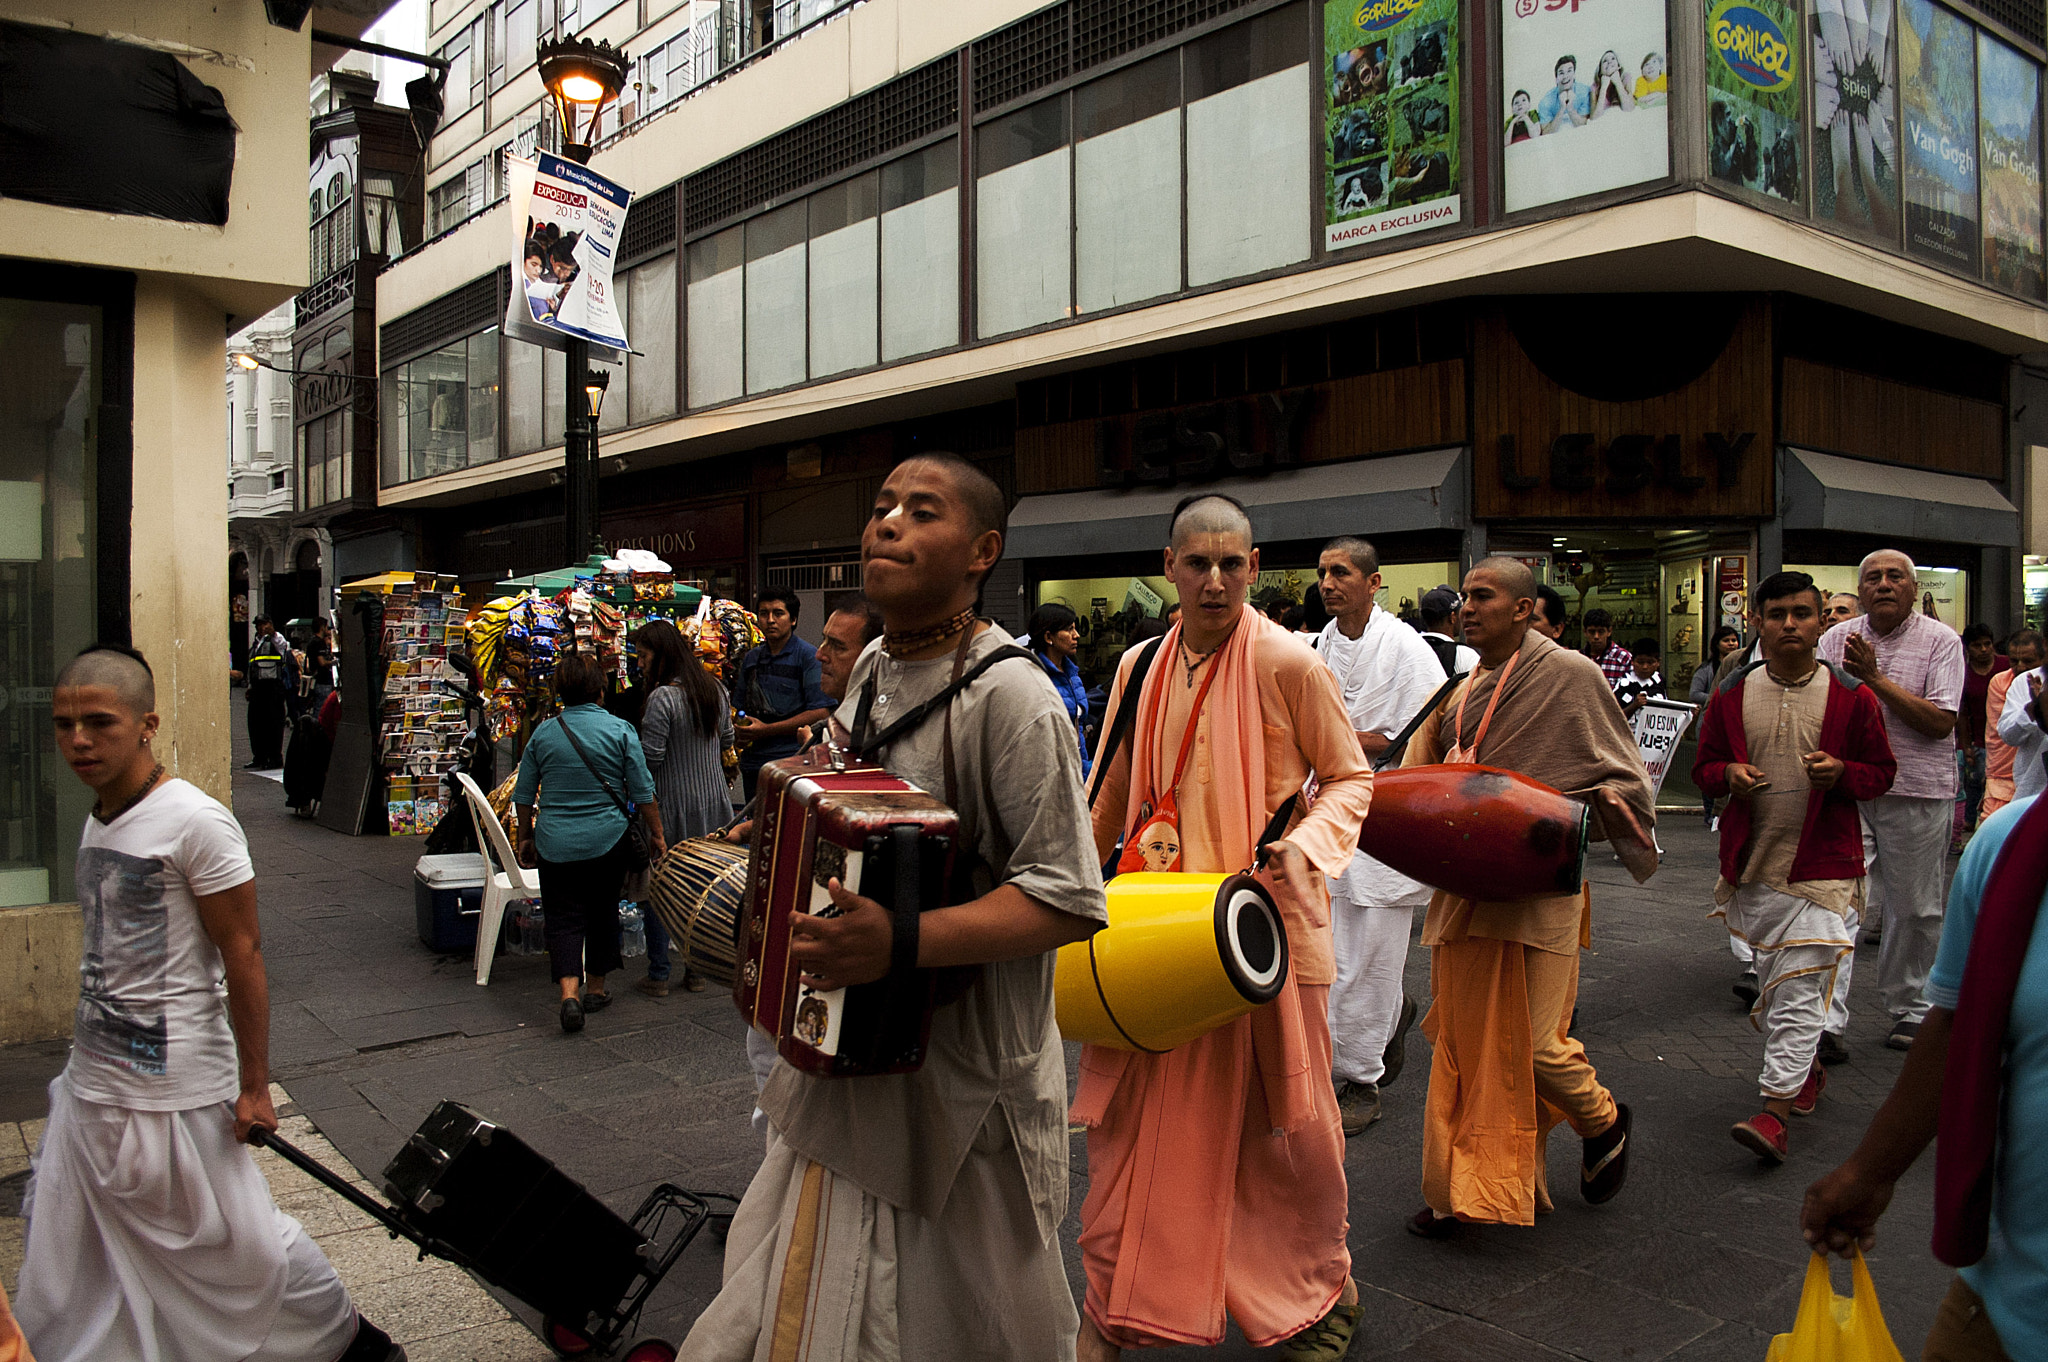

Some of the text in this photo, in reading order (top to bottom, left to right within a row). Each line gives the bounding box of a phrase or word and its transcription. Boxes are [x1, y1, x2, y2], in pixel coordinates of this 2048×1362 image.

[1842, 75, 1871, 100] spiel
[1909, 120, 1974, 176] Van Gogh
[1983, 136, 2040, 187] Van Gogh
[537, 184, 586, 208] EXPOEDUCA
[555, 204, 581, 220] 2015
[1331, 206, 1454, 243] MARCA EXCLUSIVA
[1928, 221, 1956, 240] CALZADO
[1096, 388, 1311, 485] LESLY
[1498, 432, 1758, 491] LESLY
[1644, 713, 1656, 730] NO
[1656, 715, 1666, 731] ES
